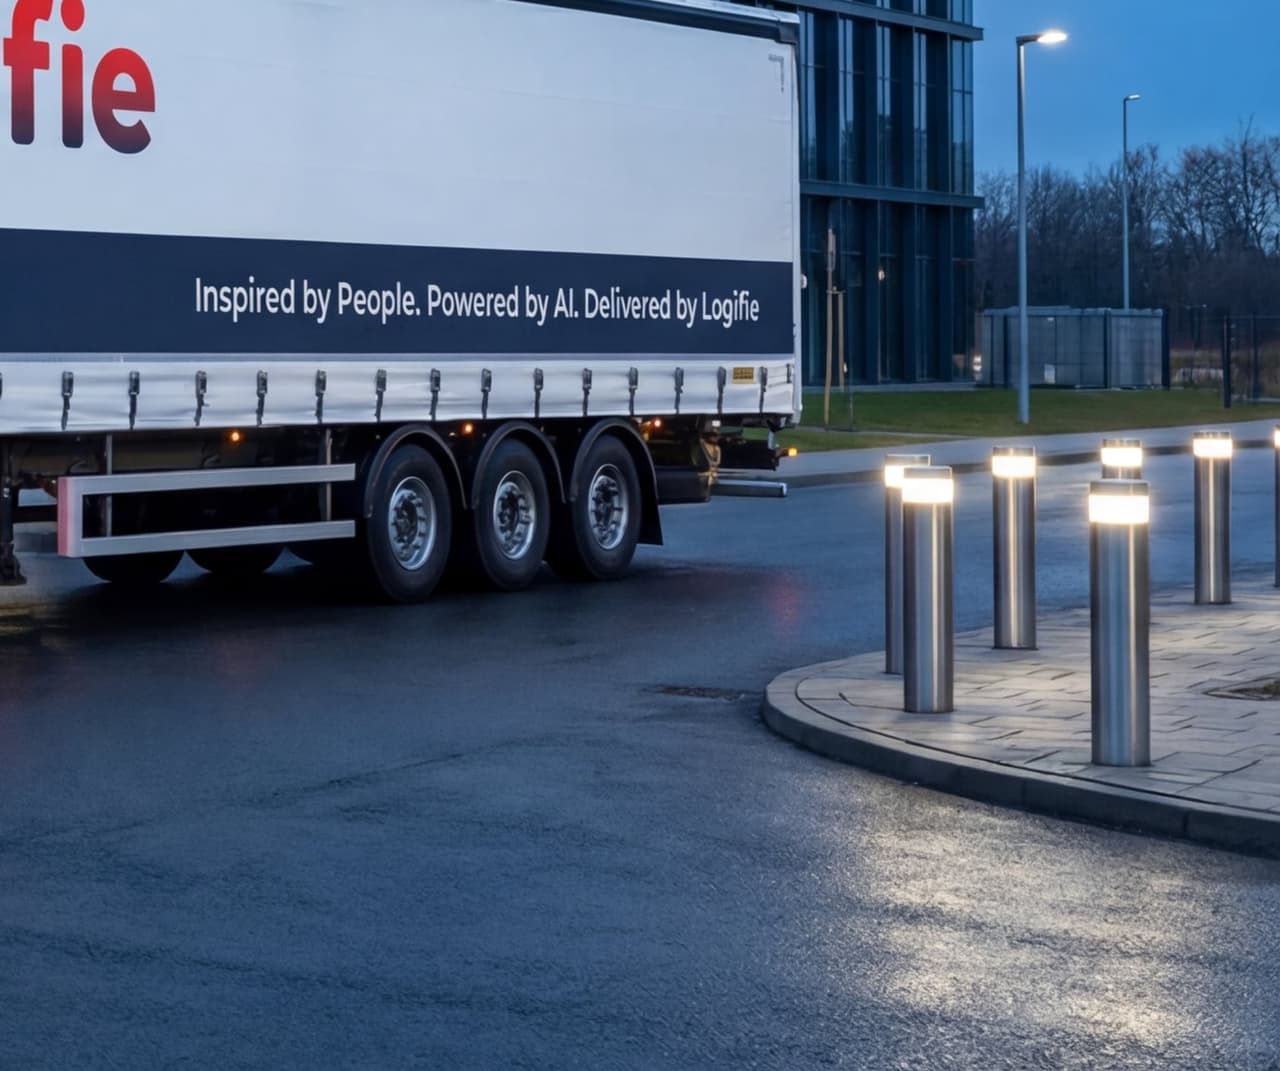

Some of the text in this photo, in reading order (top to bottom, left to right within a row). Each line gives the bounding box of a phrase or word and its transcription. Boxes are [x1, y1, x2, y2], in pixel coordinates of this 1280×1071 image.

[196, 276, 760, 329] Inspired by People. Powered by AI. Delivered by Logifie
